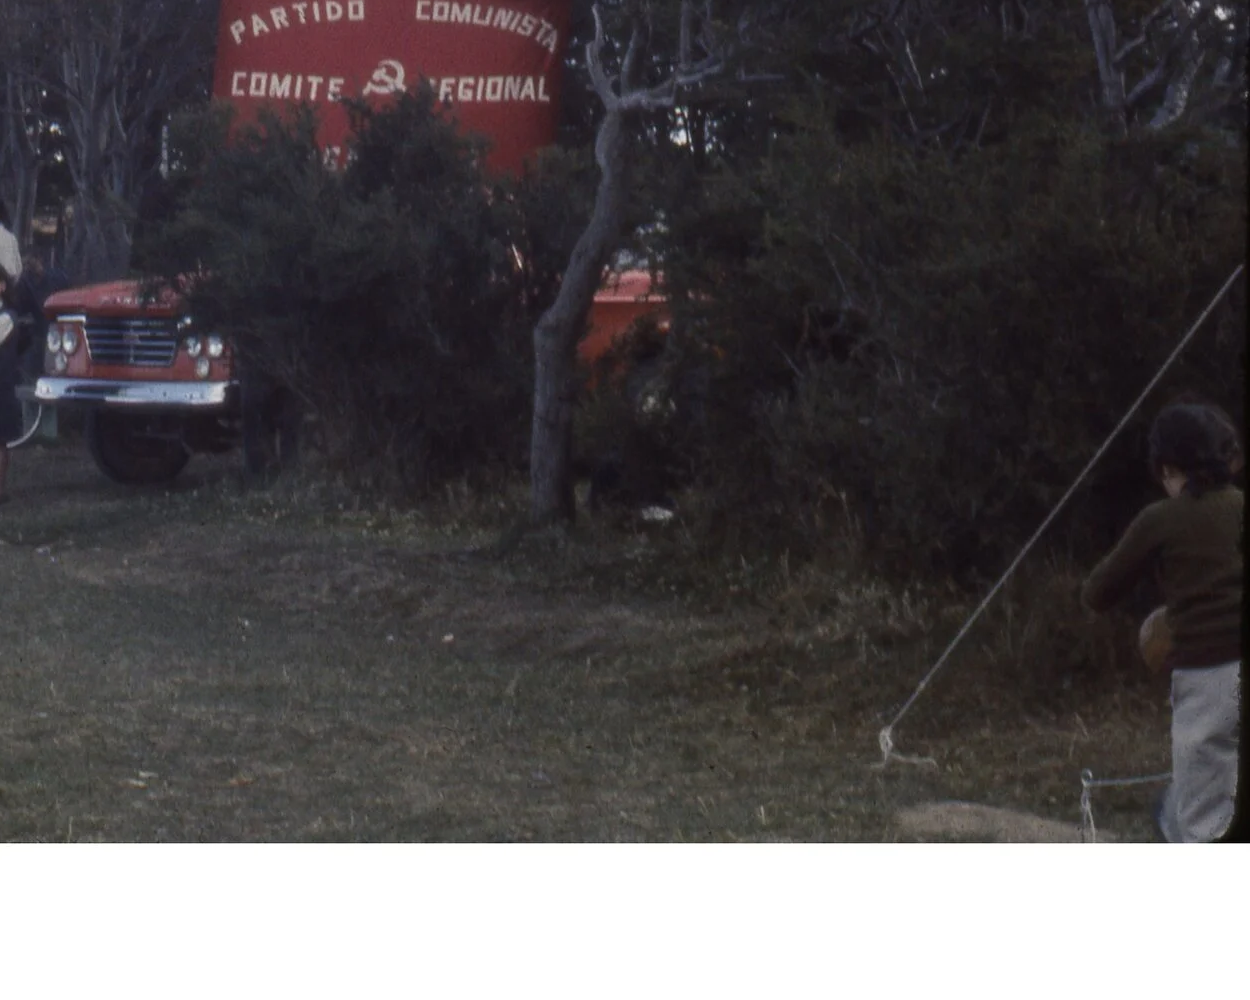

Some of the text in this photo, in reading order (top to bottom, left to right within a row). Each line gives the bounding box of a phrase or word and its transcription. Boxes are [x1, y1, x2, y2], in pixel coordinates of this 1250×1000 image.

[229, 0, 560, 53] PARTIDO COMUNISTA
[231, 71, 551, 102] COMITE EGIONAL
